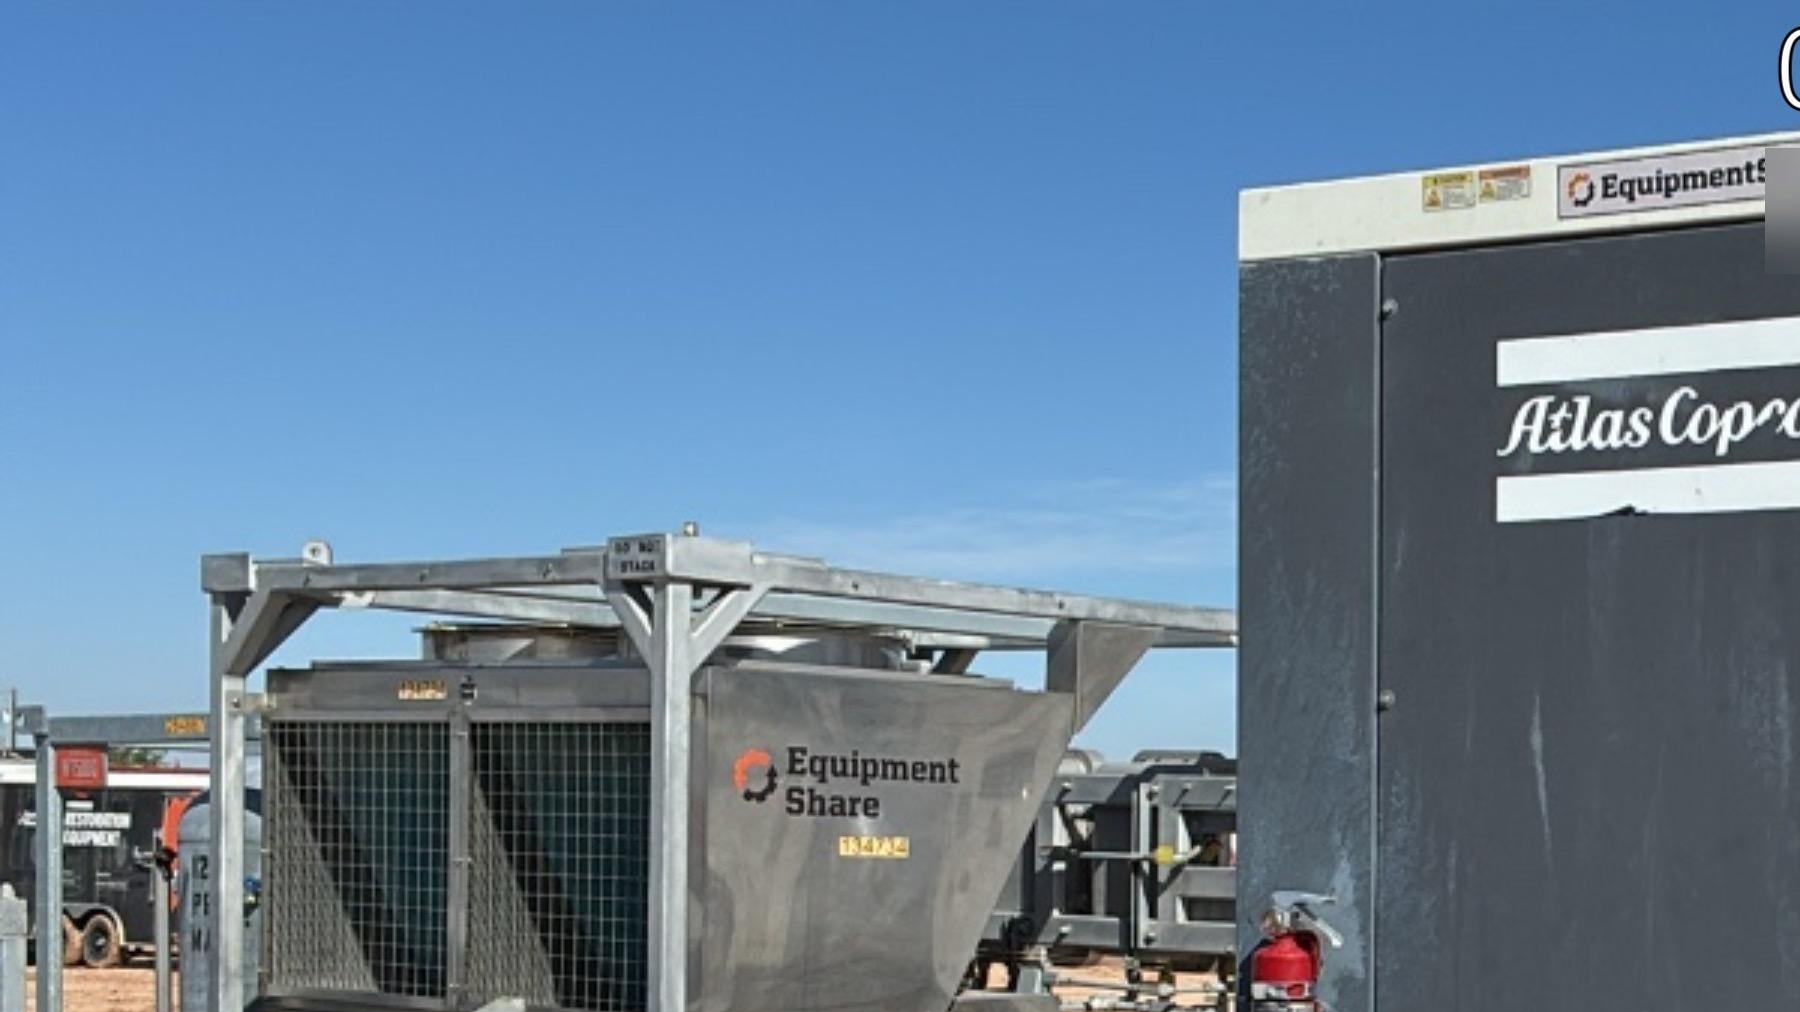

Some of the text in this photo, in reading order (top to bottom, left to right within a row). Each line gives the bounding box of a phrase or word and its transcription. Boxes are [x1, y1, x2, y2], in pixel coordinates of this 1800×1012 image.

[1496, 394, 1653, 457] Atlas
[786, 746, 961, 786] Equipment
[785, 785, 881, 818] Share
